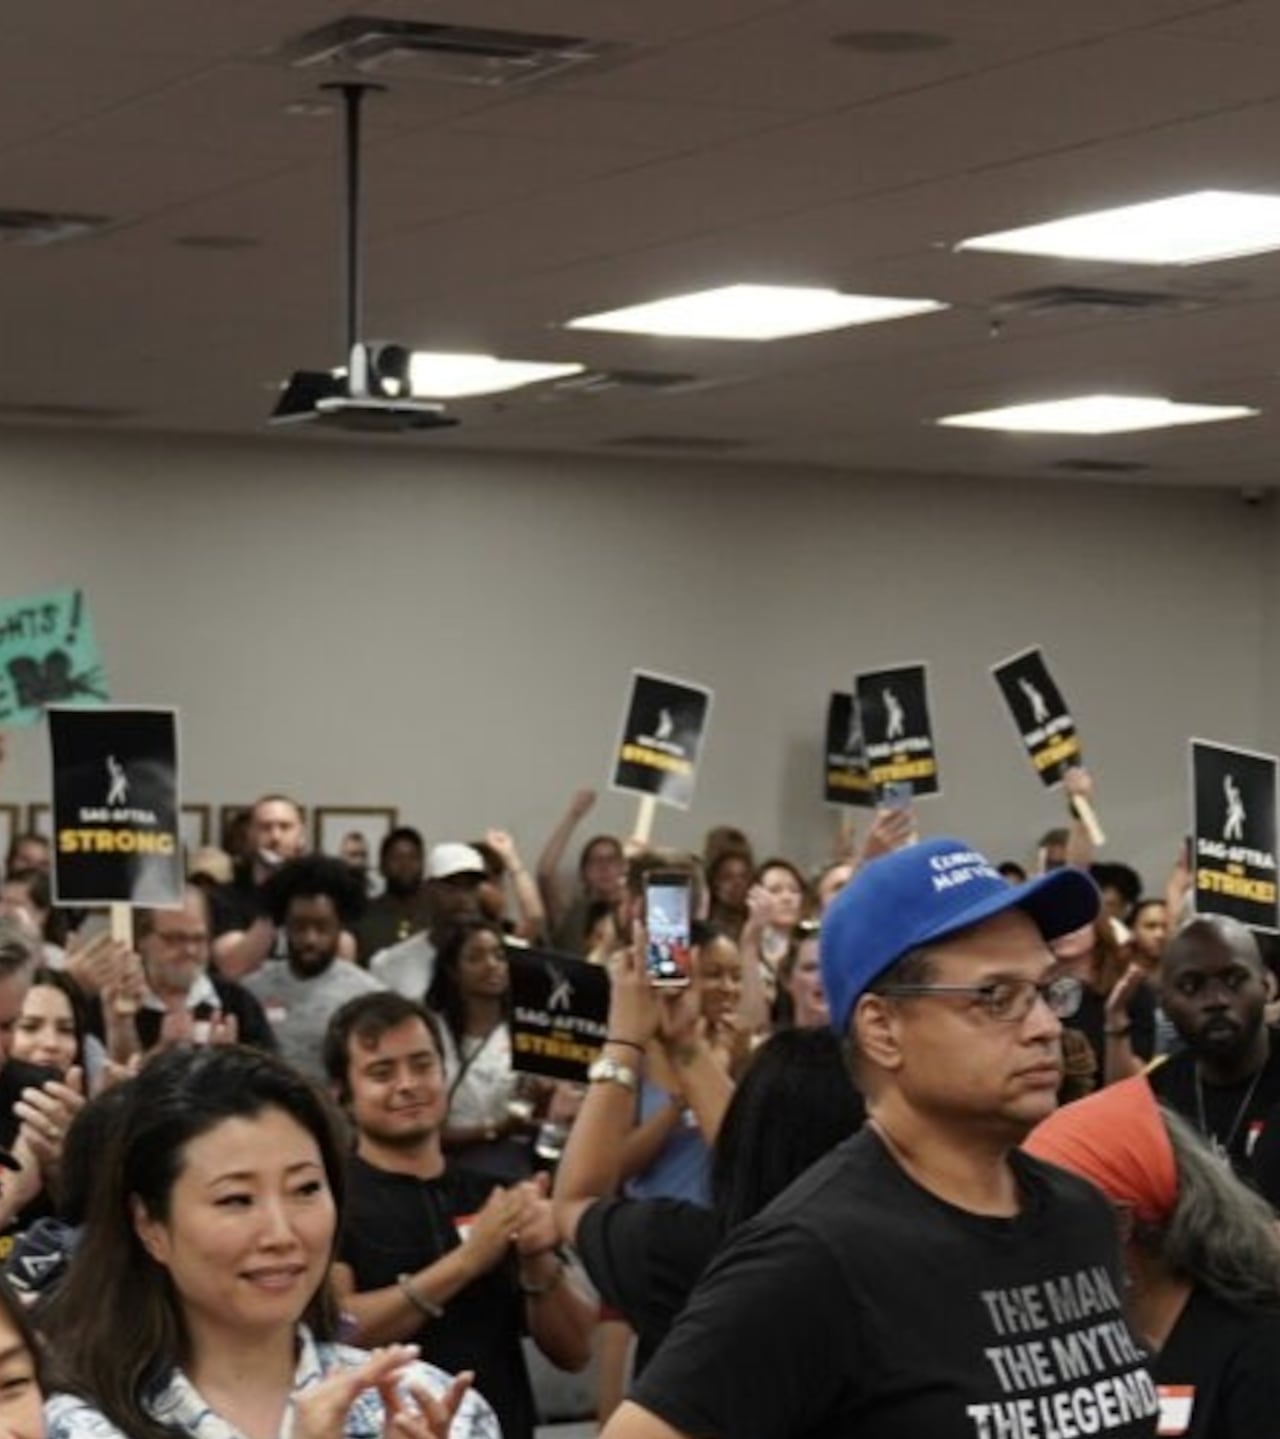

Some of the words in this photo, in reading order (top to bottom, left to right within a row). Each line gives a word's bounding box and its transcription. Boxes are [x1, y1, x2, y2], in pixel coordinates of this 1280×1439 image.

[59, 828, 175, 855] STRONG
[980, 1284, 1048, 1336] THE
[984, 1342, 1057, 1393] THE
